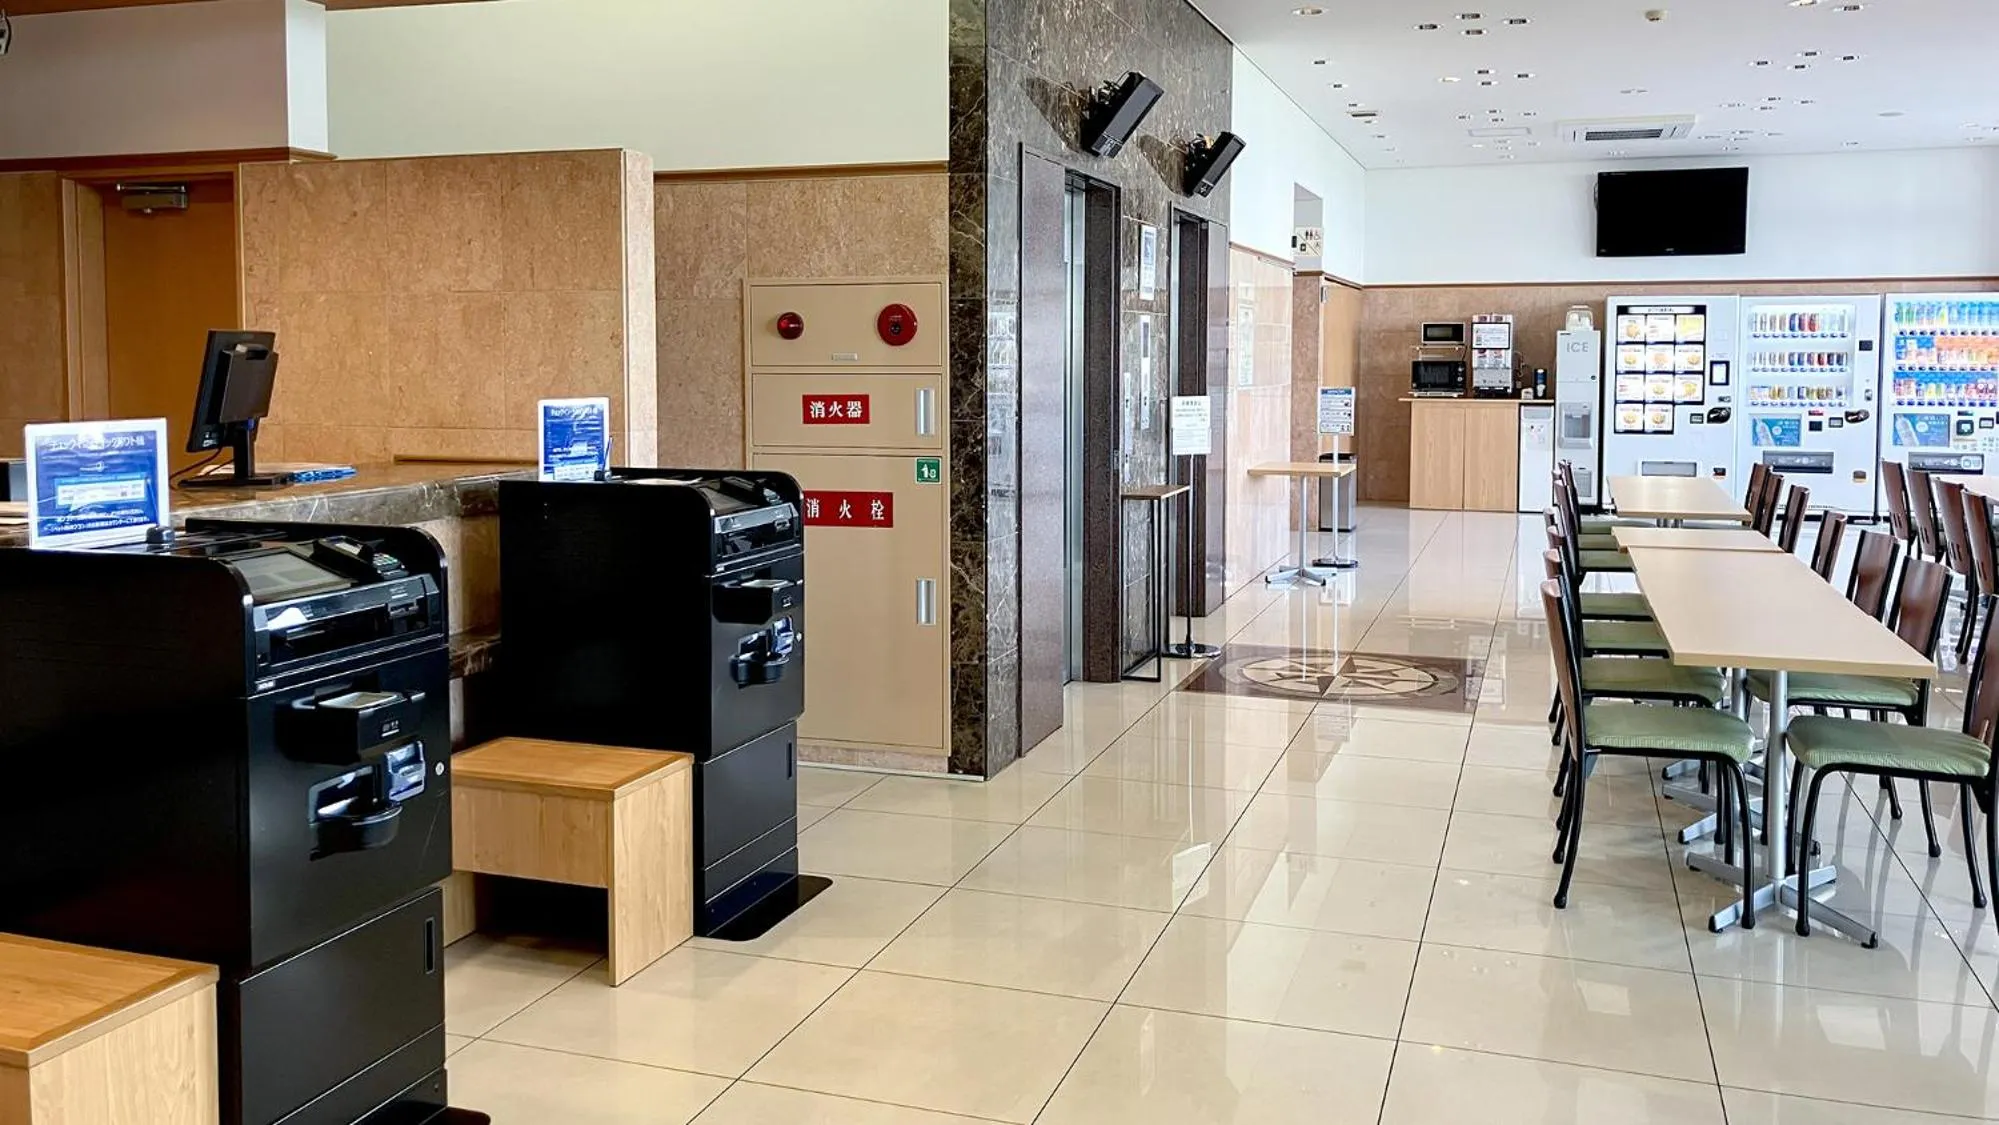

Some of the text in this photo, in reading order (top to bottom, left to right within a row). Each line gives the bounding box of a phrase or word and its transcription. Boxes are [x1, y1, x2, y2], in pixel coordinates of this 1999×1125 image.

[1566, 341, 1589, 353] ICE
[809, 400, 862, 418] 消火器
[806, 498, 885, 520] 消火栓
